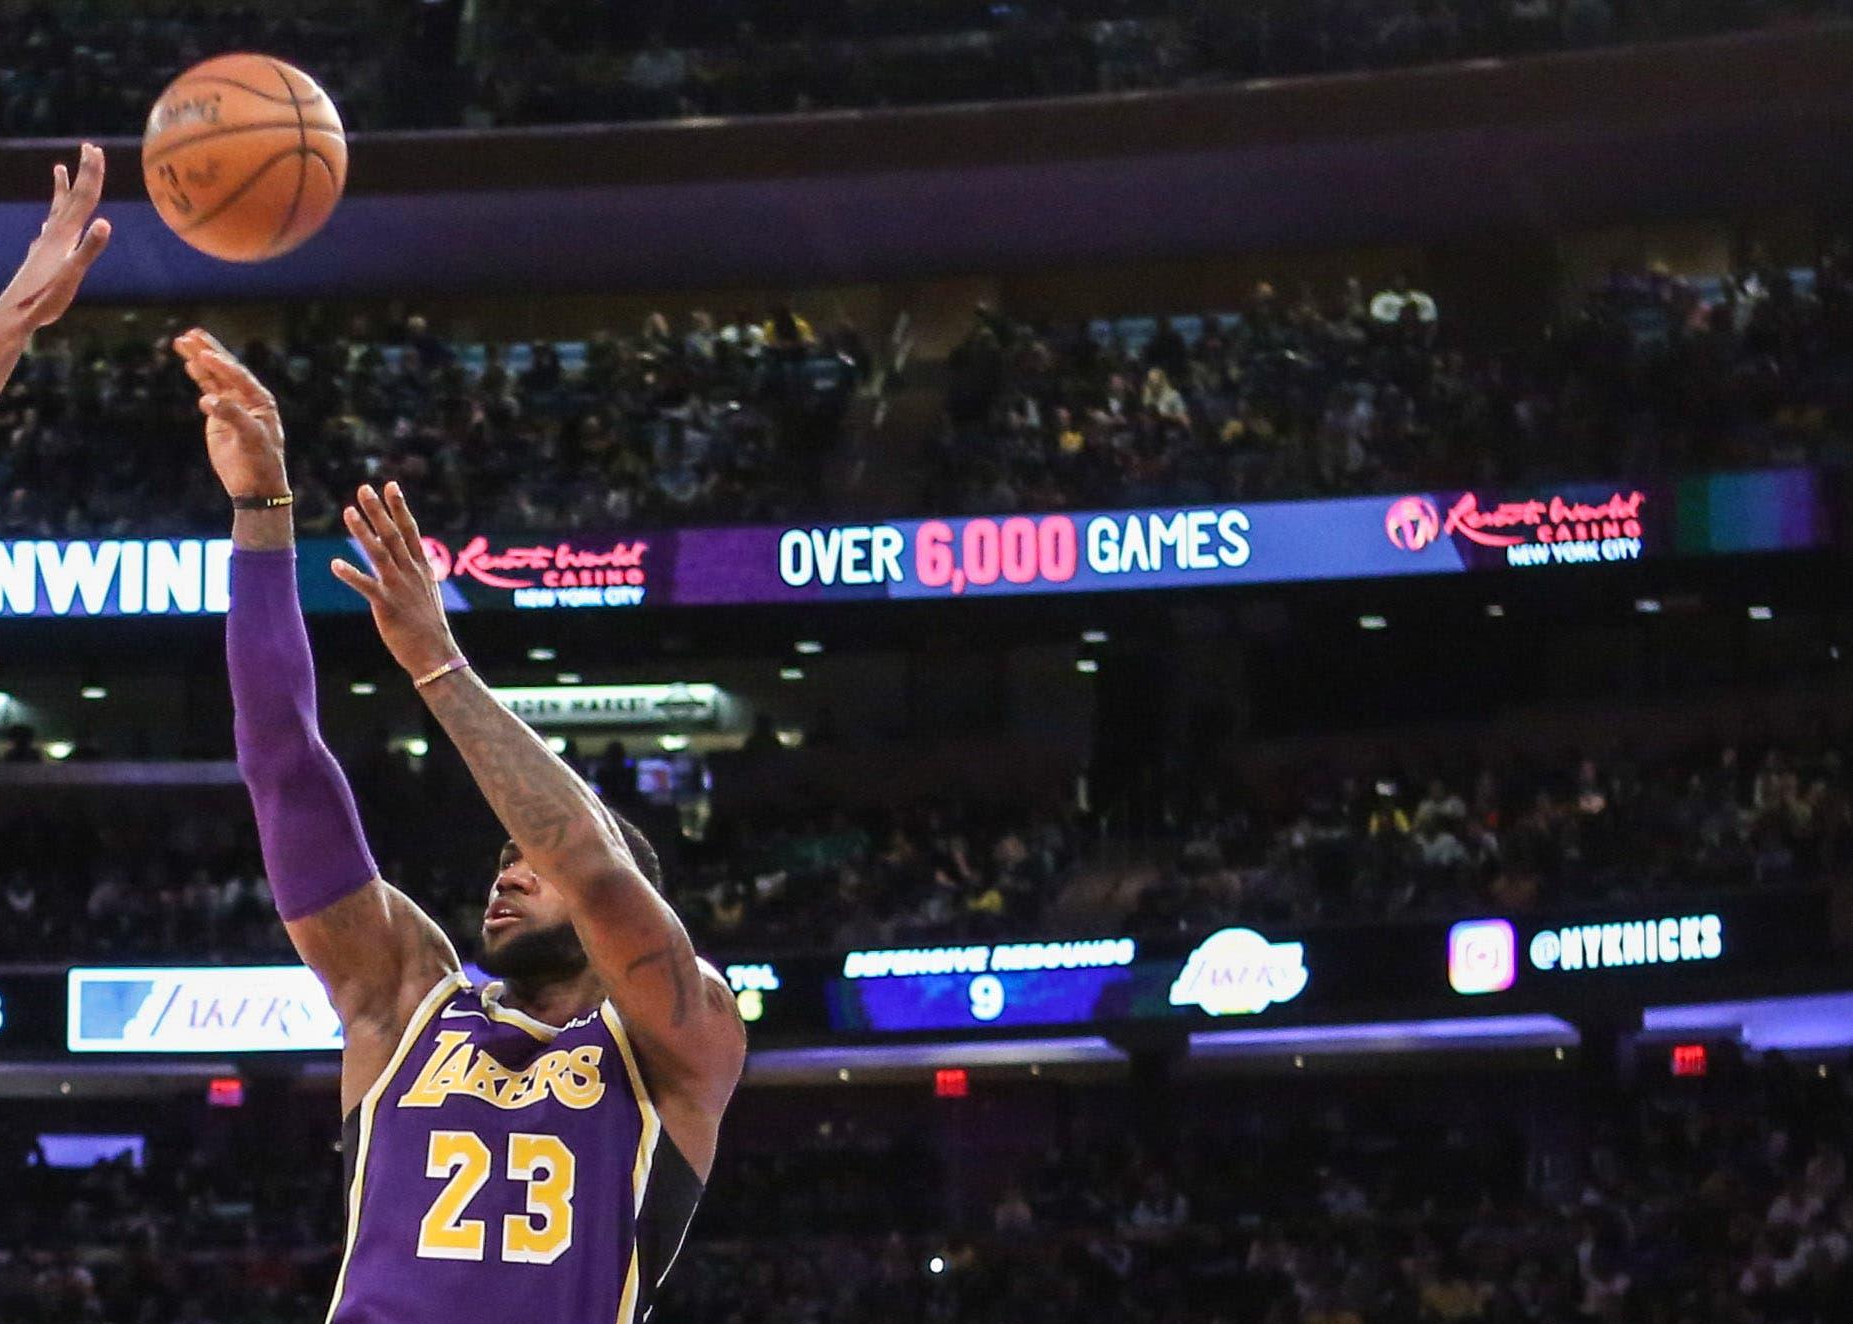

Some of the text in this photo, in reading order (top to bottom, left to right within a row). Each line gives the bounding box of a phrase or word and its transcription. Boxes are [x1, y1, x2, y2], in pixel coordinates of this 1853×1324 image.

[779, 510, 1252, 595] OVER 6,000 GAMES
[1506, 536, 1642, 567] NEW YORK CITY
[1536, 519, 1642, 543] CASINO
[542, 566, 645, 588] CASINO
[843, 937, 1135, 979] DEFENSIVE REBOUNDS
[1529, 913, 1723, 971] @NYKNICKS
[736, 989, 764, 1022] 6
[969, 973, 1005, 1022] 9
[397, 1030, 607, 1110] LAKERS
[415, 1130, 576, 1265] 23
